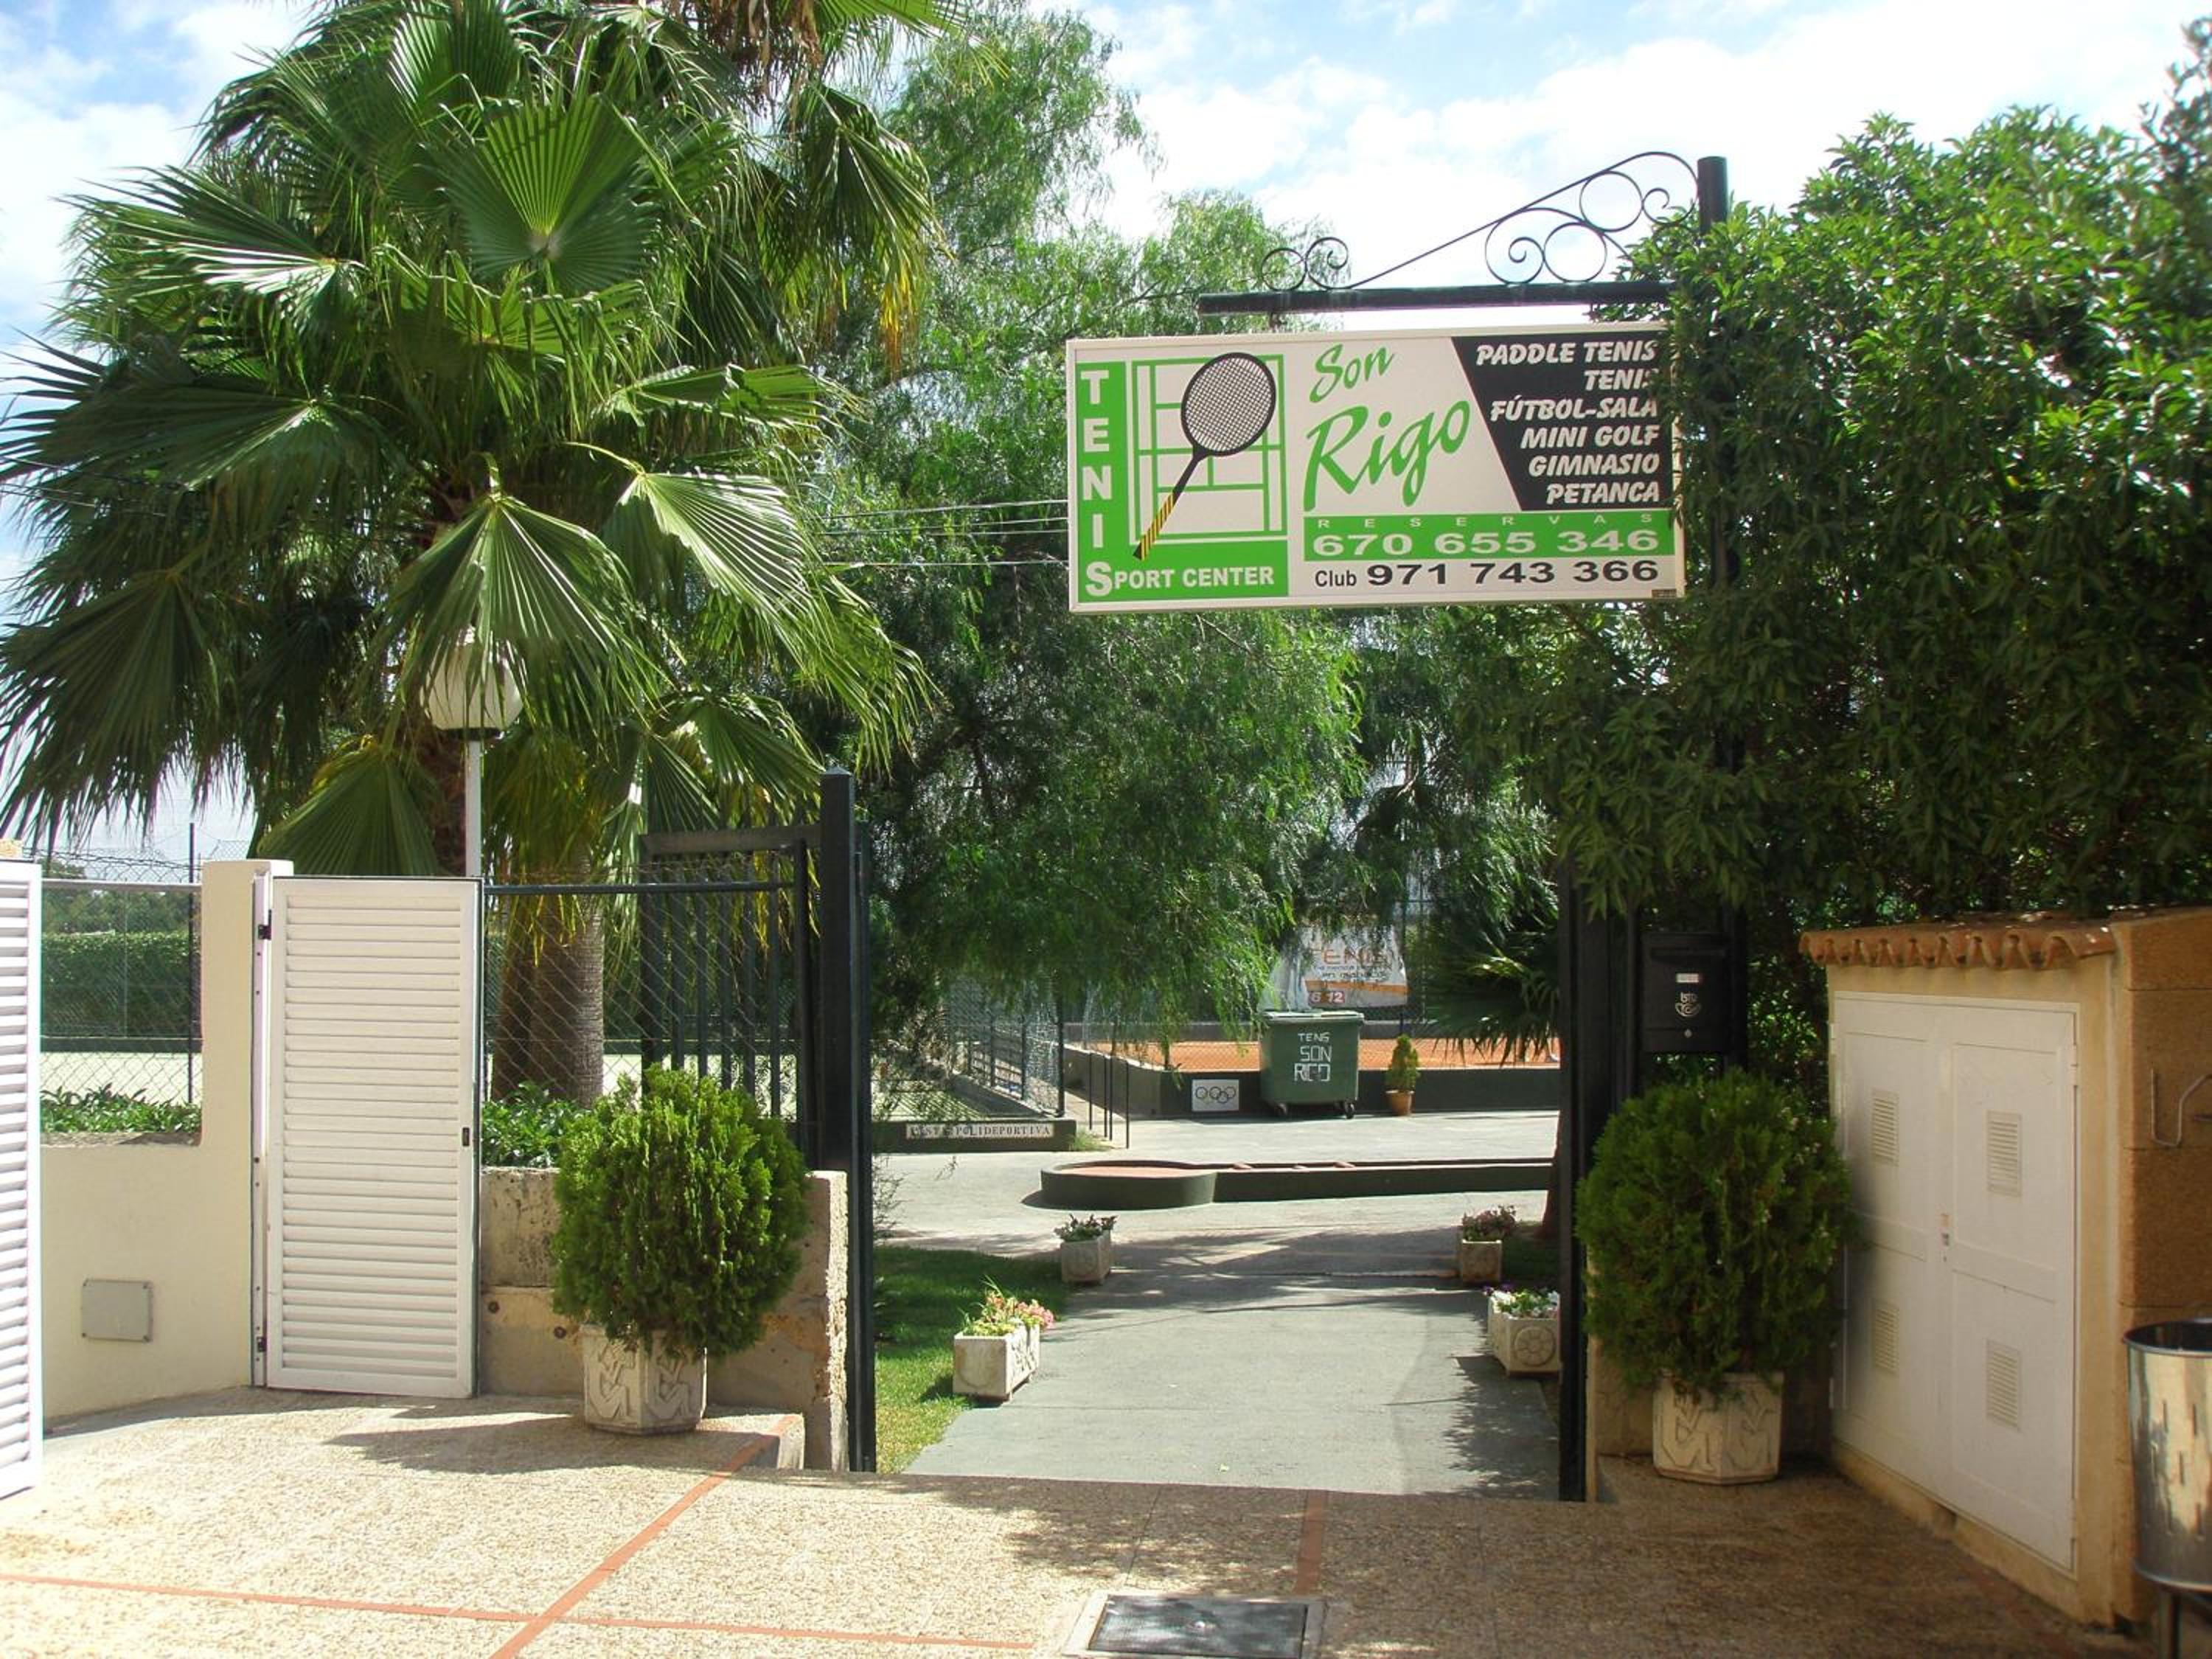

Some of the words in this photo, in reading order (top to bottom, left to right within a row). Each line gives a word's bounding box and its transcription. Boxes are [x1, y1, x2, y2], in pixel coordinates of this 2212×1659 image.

[1476, 342, 1576, 366] PADDLE
[1583, 340, 1658, 363] TENIS
[1309, 344, 1395, 403] Son
[1489, 394, 1658, 422] FÚTBOL-SALA
[1520, 427, 1587, 449] MINI
[1594, 425, 1660, 447] GOLF
[1303, 400, 1470, 512] Rigo
[1528, 453, 1660, 477] GIMNASIO
[1545, 481, 1659, 504] PETANCA
[1318, 513, 1653, 529] RESERVAS
[1312, 533, 1413, 557] 670
[1434, 532, 1537, 554] 655
[1557, 529, 1659, 552] 346
[1183, 567, 1275, 588] CENTER
[1315, 570, 1357, 588] Club
[1367, 563, 1446, 586] 971
[1470, 561, 1555, 584] 743
[1573, 560, 1659, 582] 366
[1300, 1045, 1332, 1062] SON
[957, 1124, 1051, 1137] POLIDEPORTIVA
